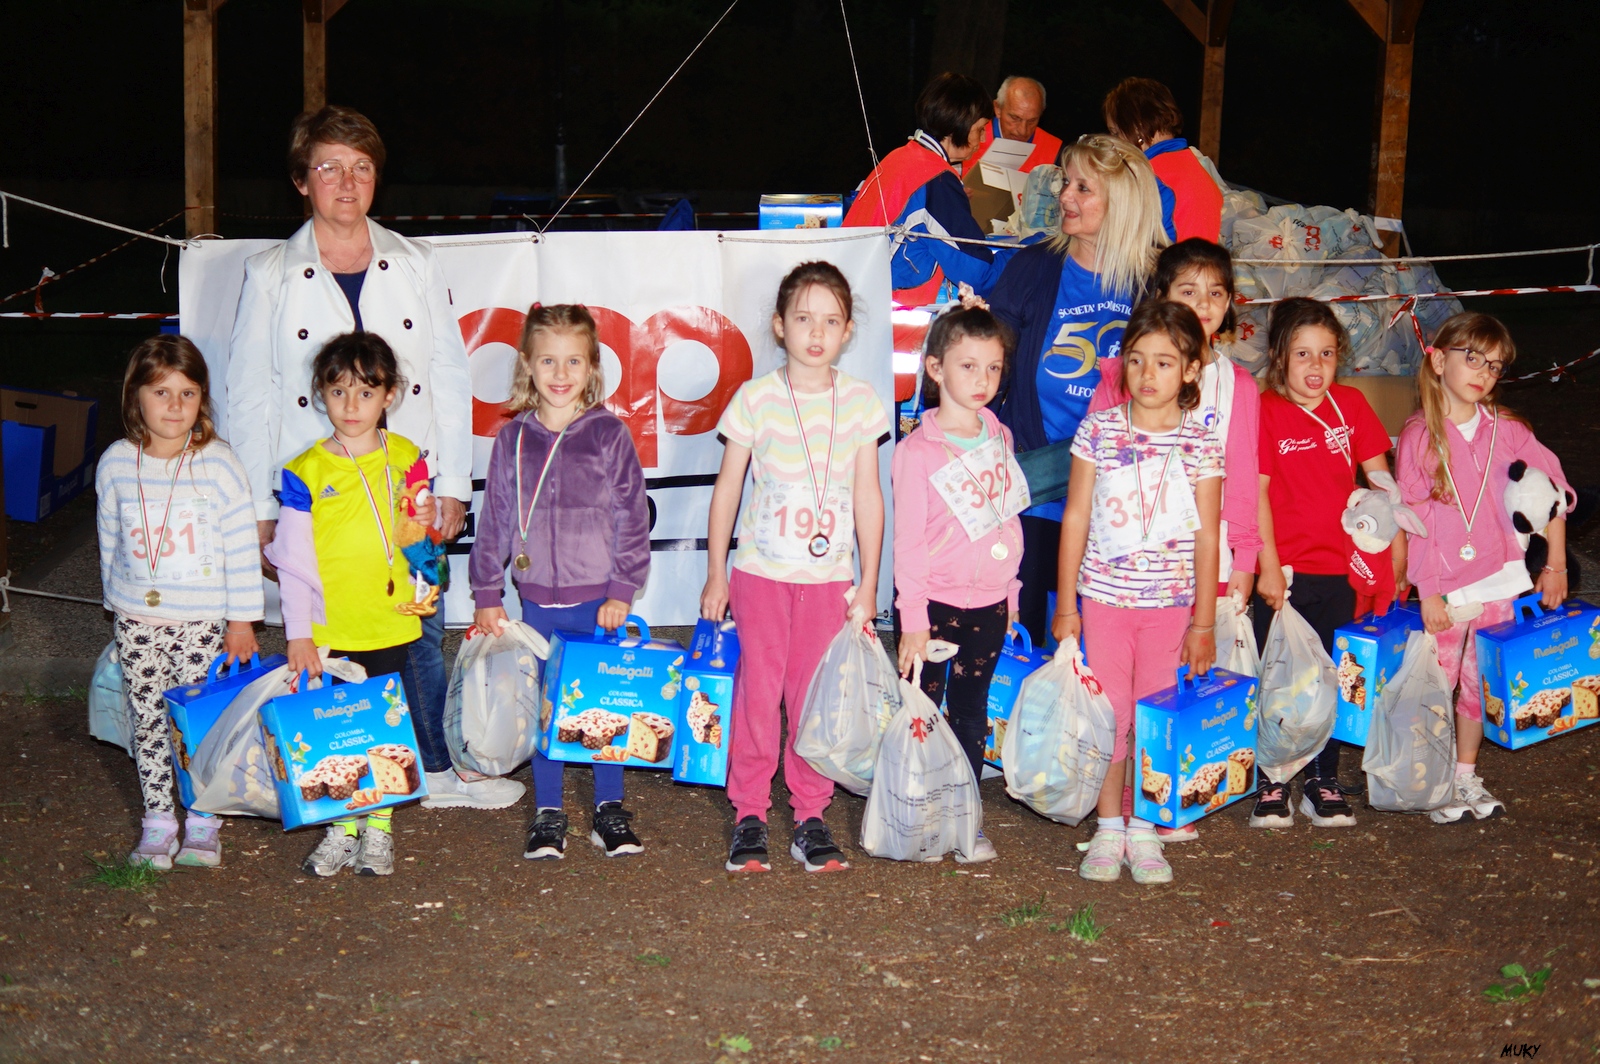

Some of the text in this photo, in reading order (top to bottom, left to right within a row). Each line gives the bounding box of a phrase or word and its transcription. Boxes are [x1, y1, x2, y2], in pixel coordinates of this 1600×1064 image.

[1065, 384, 1096, 398] ALFO
[961, 462, 1012, 509] 329
[1105, 481, 1169, 528] 337
[774, 506, 836, 540] 199
[130, 522, 196, 560] 331
[1542, 668, 1579, 686] CLASSICA
[600, 696, 644, 708] CLASSICA
[328, 734, 375, 750] CLASSICA
[334, 728, 365, 740] COLOMBA
